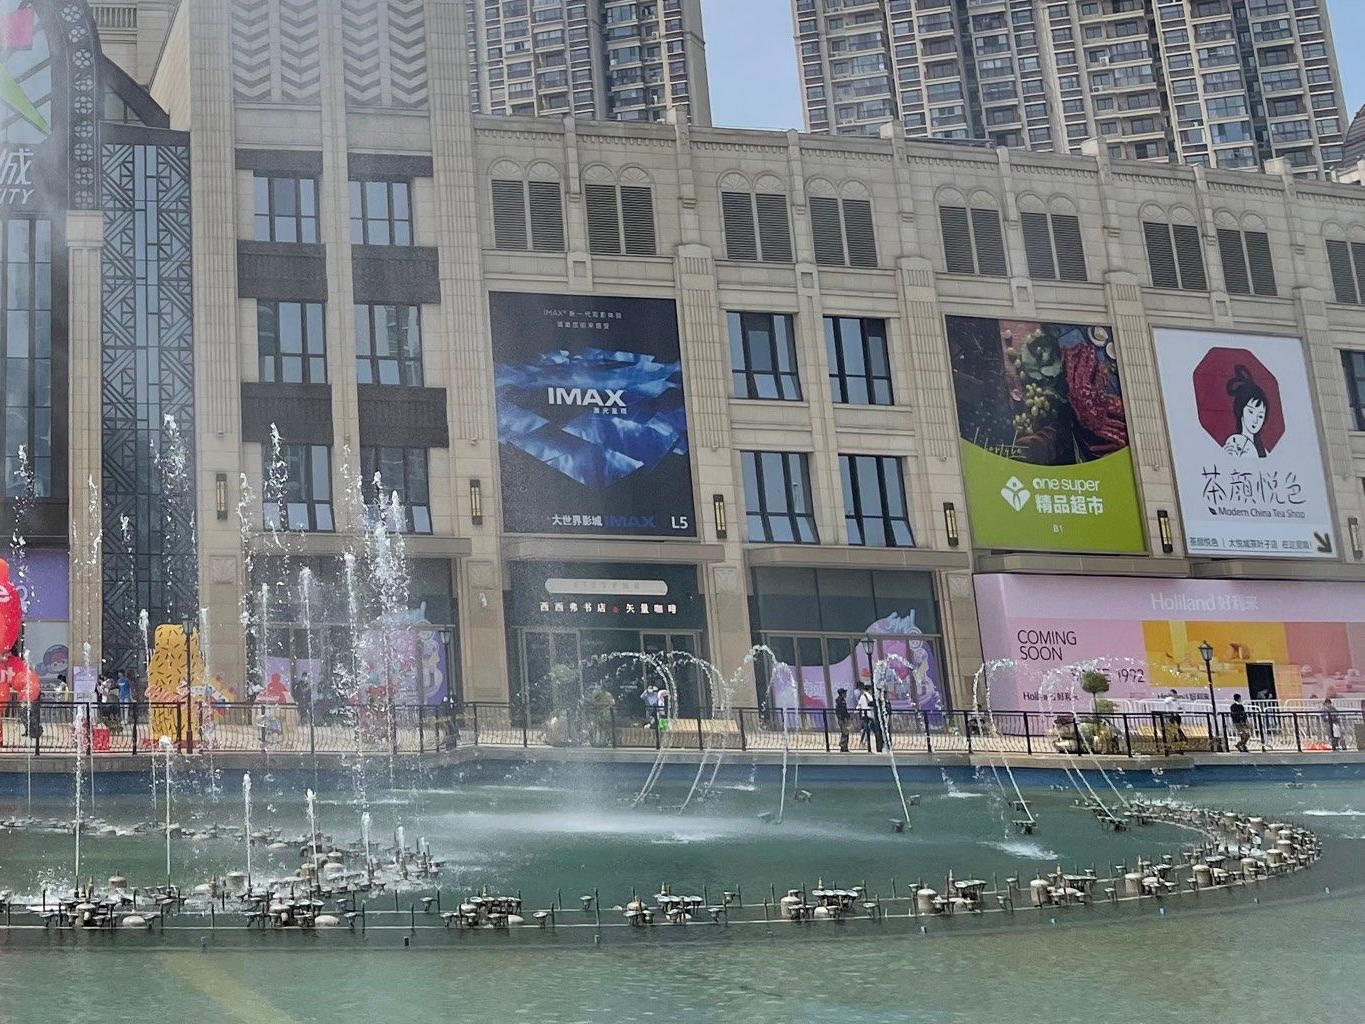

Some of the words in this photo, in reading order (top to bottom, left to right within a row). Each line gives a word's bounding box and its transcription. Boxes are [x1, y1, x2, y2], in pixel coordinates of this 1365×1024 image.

[547, 387, 627, 407] IMAX
[1032, 478, 1060, 490] one
[1061, 479, 1100, 494] super
[1035, 494, 1104, 515] 精品超市
[551, 514, 603, 527] 大世界影城
[1218, 507, 1249, 517] Modern
[1250, 508, 1272, 518] China
[1272, 508, 1286, 518] Tea
[1287, 509, 1306, 519] Shop
[671, 516, 689, 529] L5
[540, 602, 606, 613] 西西弗书店
[626, 603, 677, 614] 矢量咖啡
[1151, 593, 1215, 611] Holiland
[1217, 594, 1260, 611] 好利来
[1017, 629, 1077, 646] COMING
[1019, 646, 1063, 661] SOON
